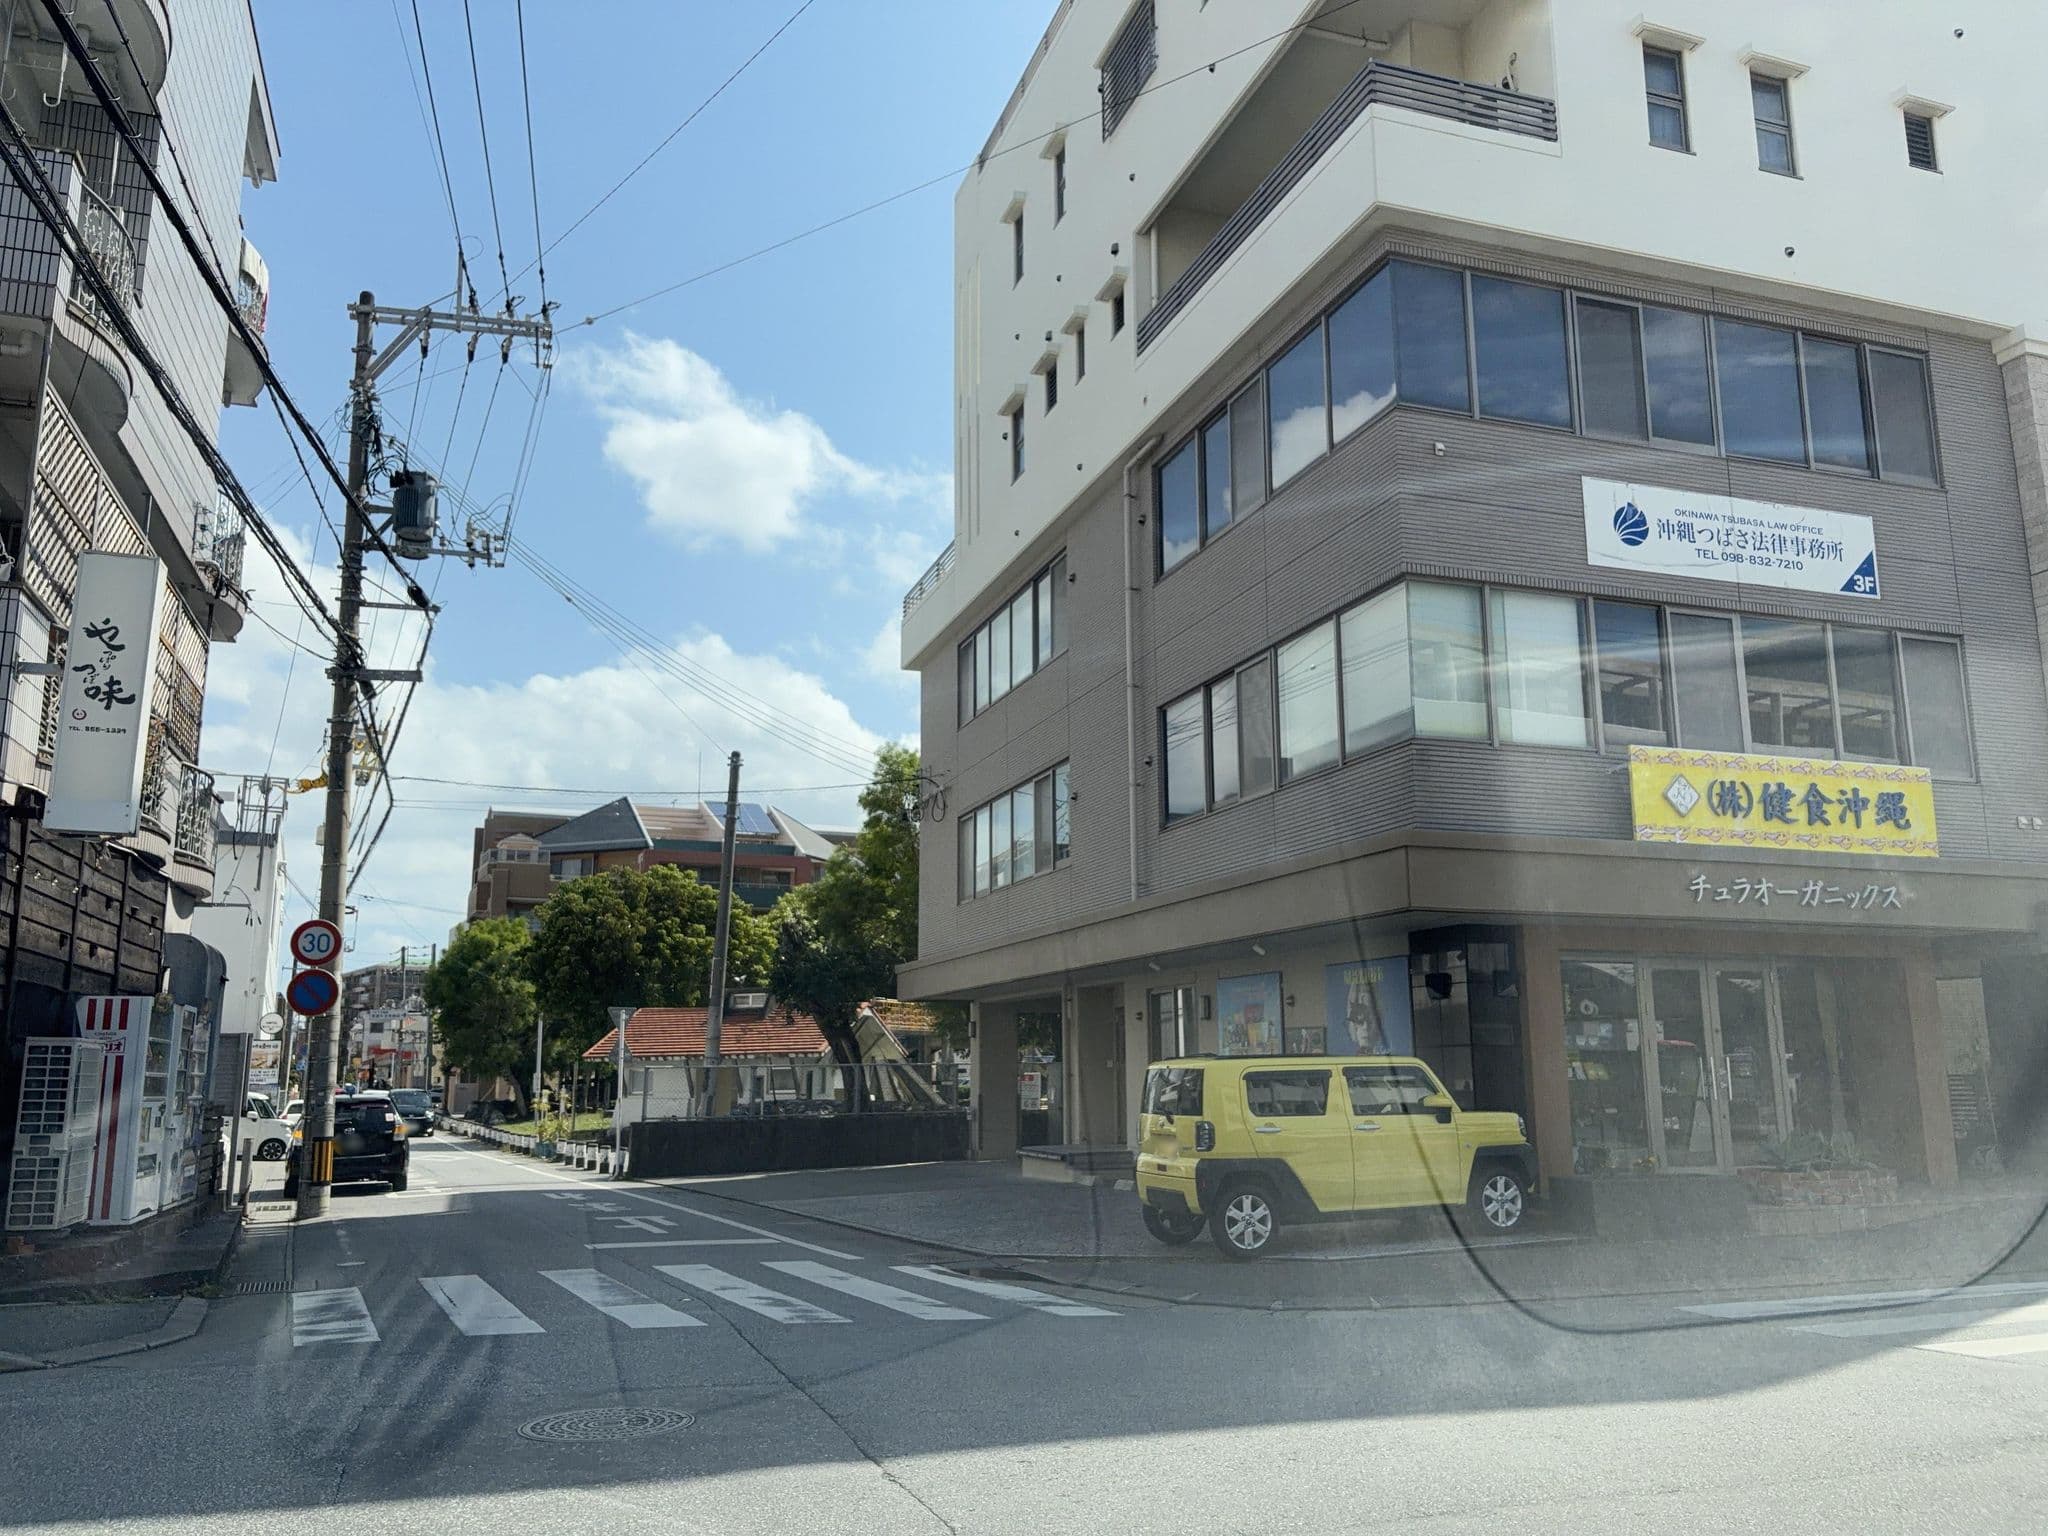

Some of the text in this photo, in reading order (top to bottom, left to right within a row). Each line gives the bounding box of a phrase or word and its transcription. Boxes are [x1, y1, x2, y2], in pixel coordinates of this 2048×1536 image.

[1674, 508, 1824, 536] OKINAWA TSUBASA LAW OFFICE
[1656, 518, 1844, 563] 沖縄つばさ法律事務所
[1695, 548, 1804, 571] TEL 098-832-7210
[1853, 575, 1875, 593] 3F
[1689, 874, 1902, 909] チュラオーガニックス
[303, 933, 331, 953] 30
